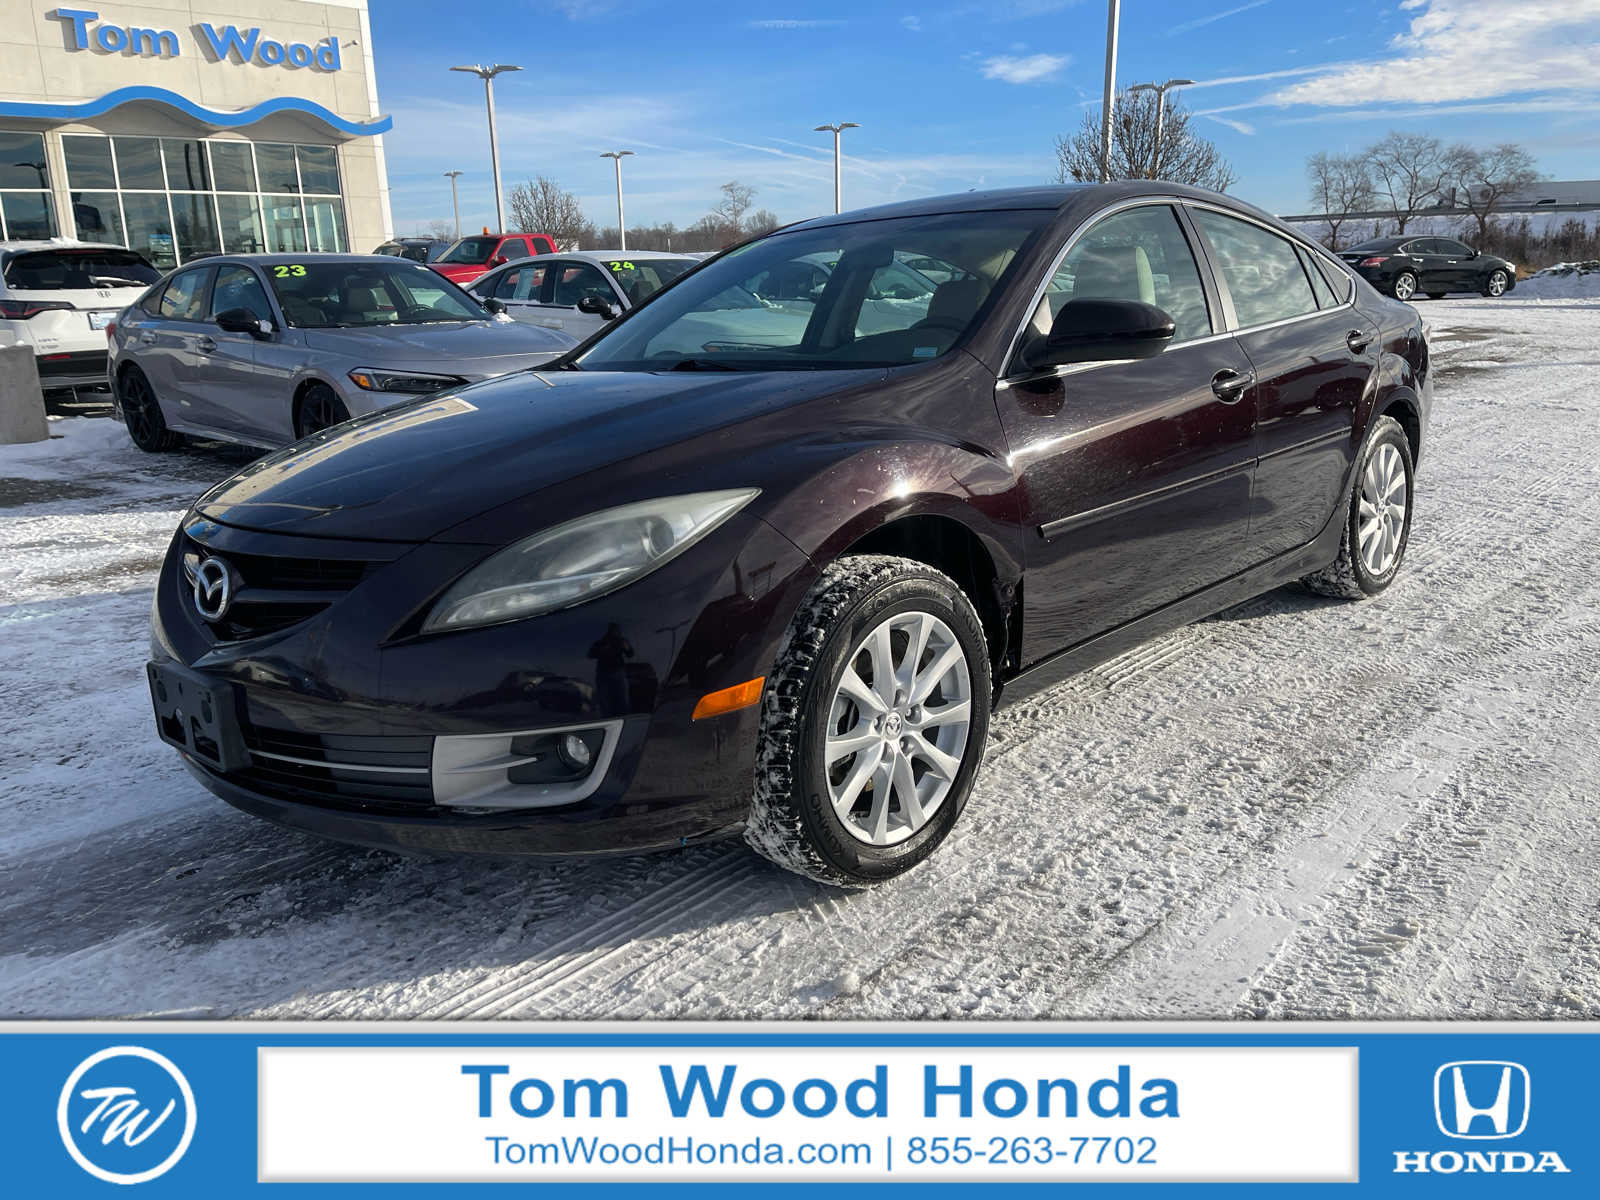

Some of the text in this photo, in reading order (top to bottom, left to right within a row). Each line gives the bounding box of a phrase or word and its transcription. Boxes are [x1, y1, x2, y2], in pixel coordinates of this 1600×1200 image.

[57, 8, 341, 71] Tom Wood
[274, 264, 307, 278] 23
[810, 792, 845, 857] KUMHO
